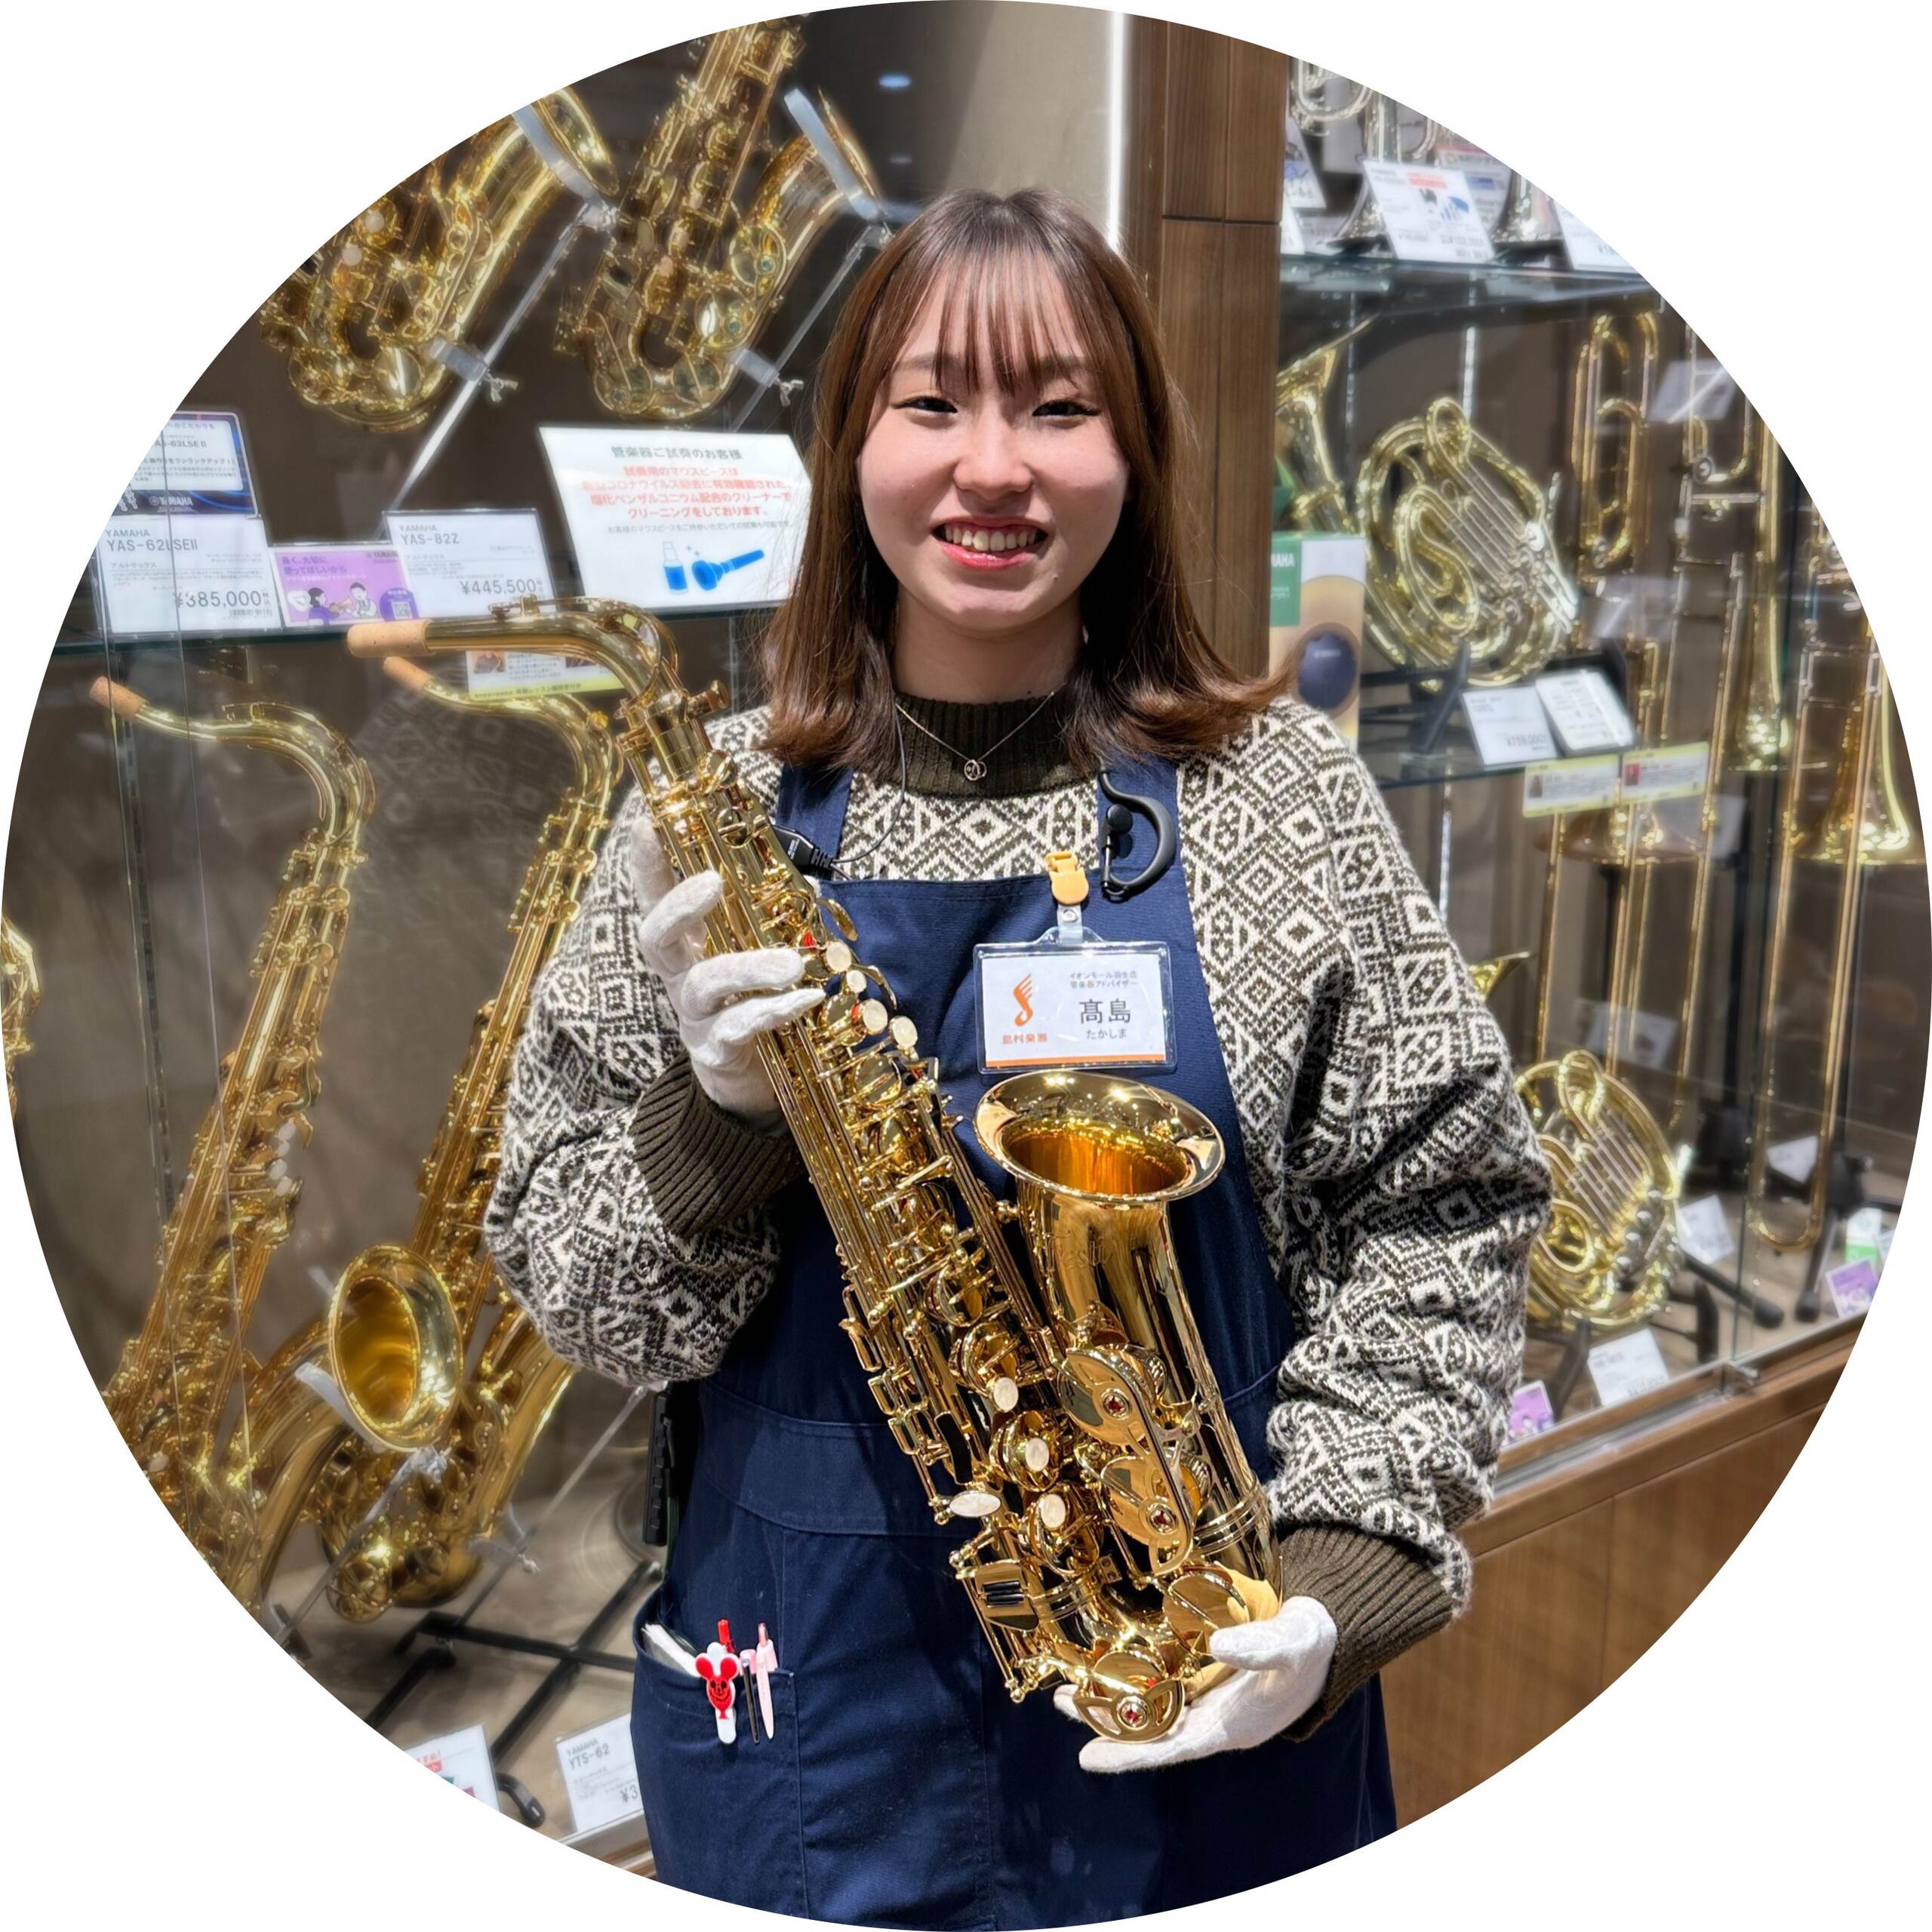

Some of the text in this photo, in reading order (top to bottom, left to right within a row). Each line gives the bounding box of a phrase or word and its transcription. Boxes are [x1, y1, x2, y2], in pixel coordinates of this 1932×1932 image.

[611, 445, 743, 460] 管楽器ご試奏のお客様
[106, 529, 150, 537] YAMAHA
[401, 533, 460, 545] YAS-82Z
[460, 579, 537, 595] ¥445,500
[174, 590, 262, 608] ¥385,000
[1069, 971, 1137, 980] イオンモール羽生店
[1070, 980, 1139, 989] 管楽器アドバイザー
[1002, 1033, 1048, 1045] 島村楽器
[1086, 1028, 1128, 1040] たかしま
[566, 1737, 598, 1756] YAMAHA
[568, 1743, 611, 1770] YTS-62
